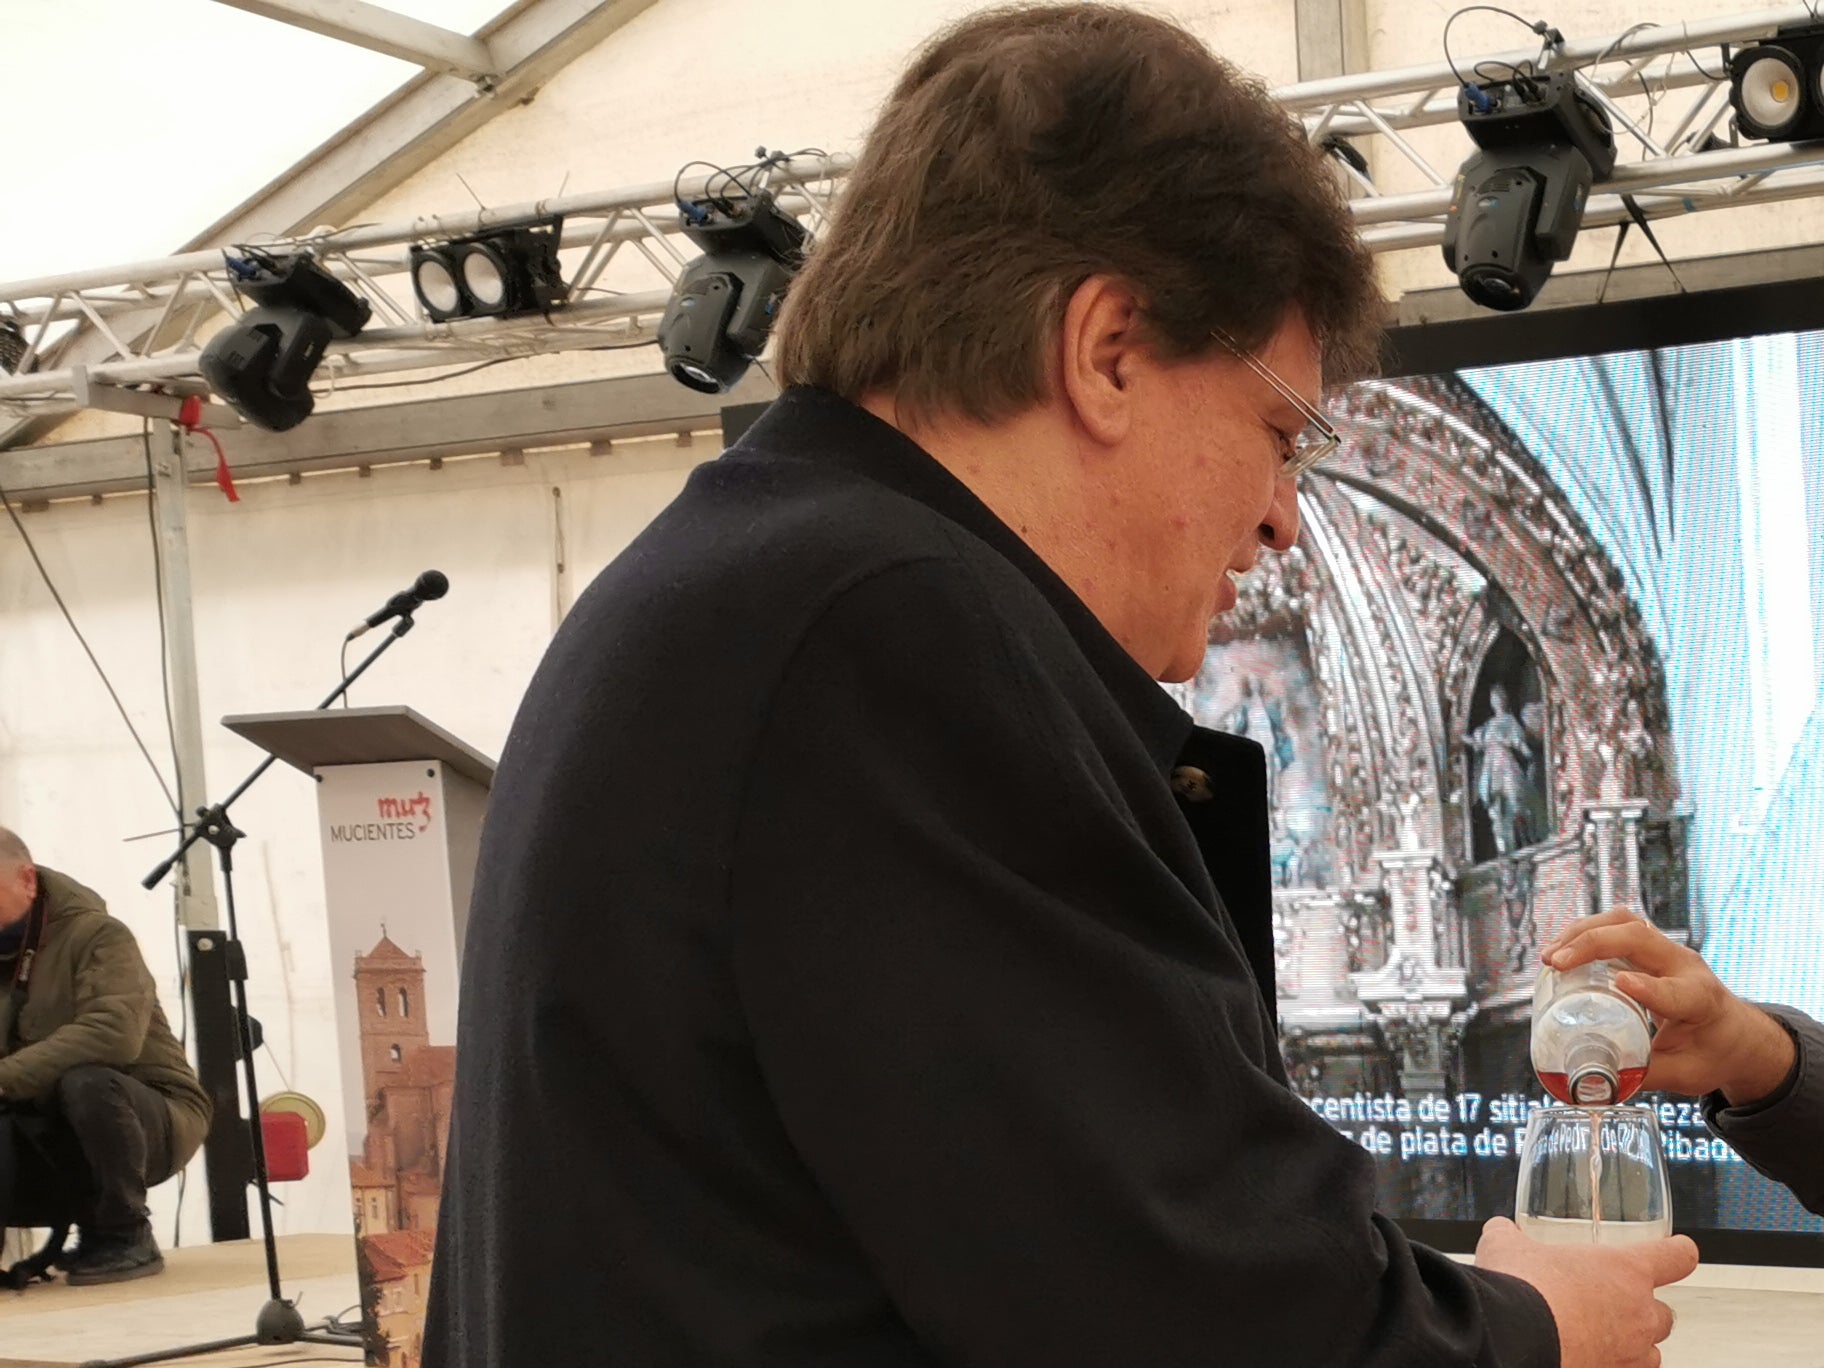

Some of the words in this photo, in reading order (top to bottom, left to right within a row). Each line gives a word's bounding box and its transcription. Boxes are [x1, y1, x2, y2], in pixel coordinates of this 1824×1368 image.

[330, 822, 415, 842] MUCIENTES
[1418, 1093, 1449, 1122] de
[1455, 1093, 1481, 1122] 17
[1360, 1126, 1392, 1154] de
[1401, 1126, 1467, 1162] plata
[1474, 1127, 1507, 1156] de
